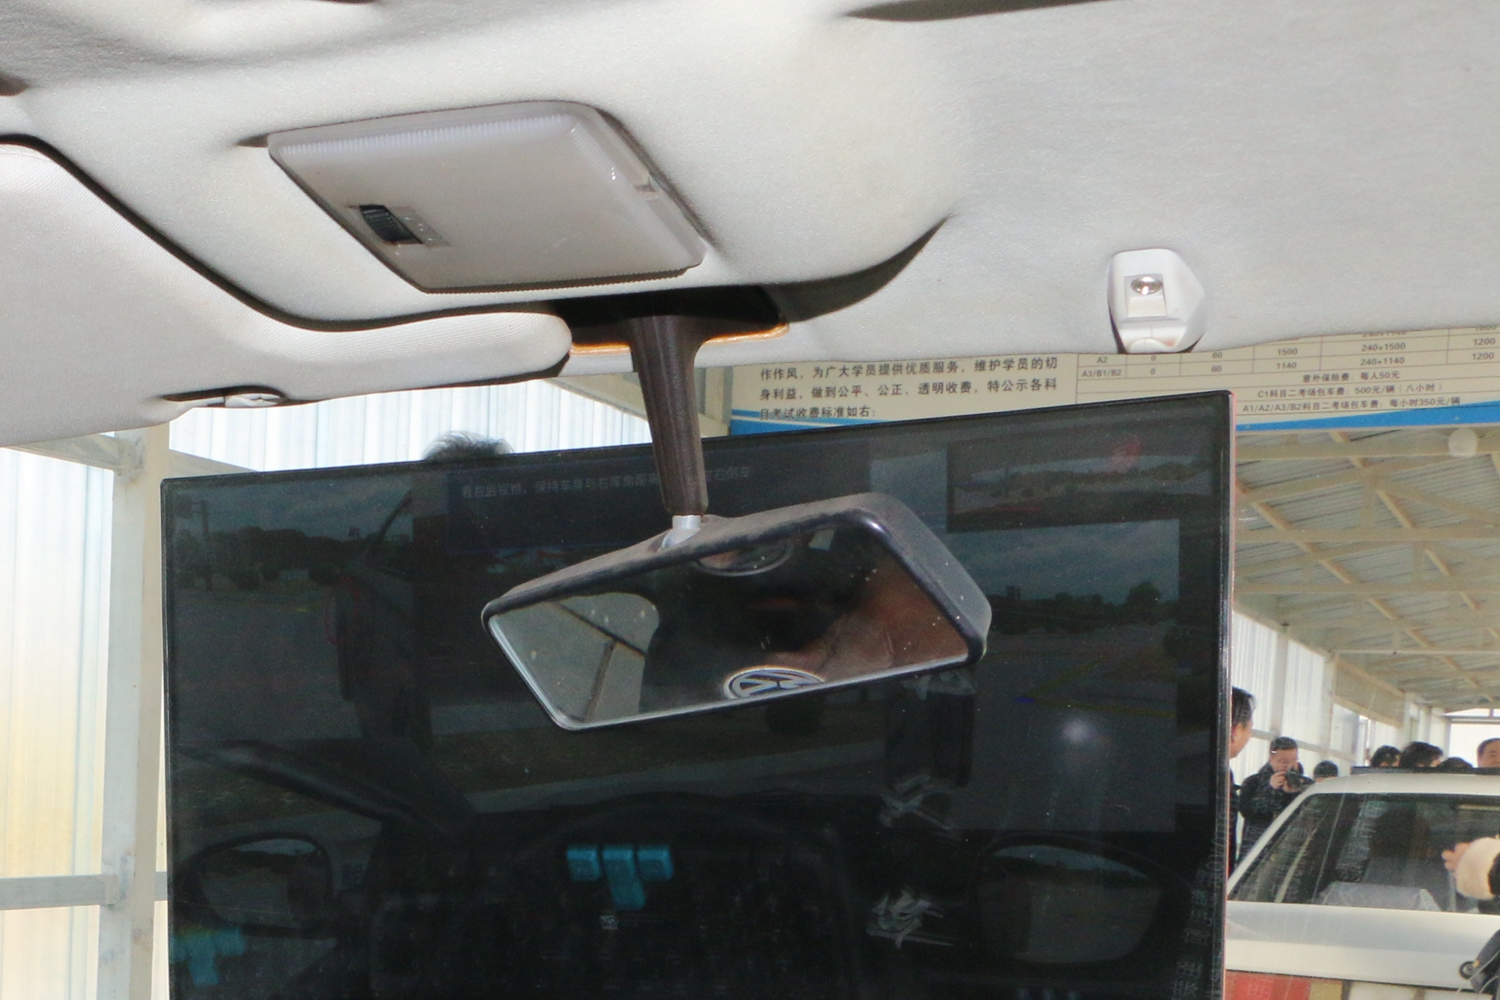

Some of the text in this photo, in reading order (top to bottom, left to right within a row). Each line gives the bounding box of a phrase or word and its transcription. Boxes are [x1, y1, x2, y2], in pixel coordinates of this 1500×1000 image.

[1096, 356, 1108, 364] A2
[1277, 348, 1298, 356] 1500
[1361, 342, 1406, 352] 240+1500
[1473, 337, 1496, 346] 1200
[1081, 369, 1122, 378] A3/B1/B2
[1211, 365, 1222, 373] 60
[1276, 361, 1297, 370] 1140
[1360, 356, 1405, 366] 240+1140
[1472, 352, 1495, 361] 1200
